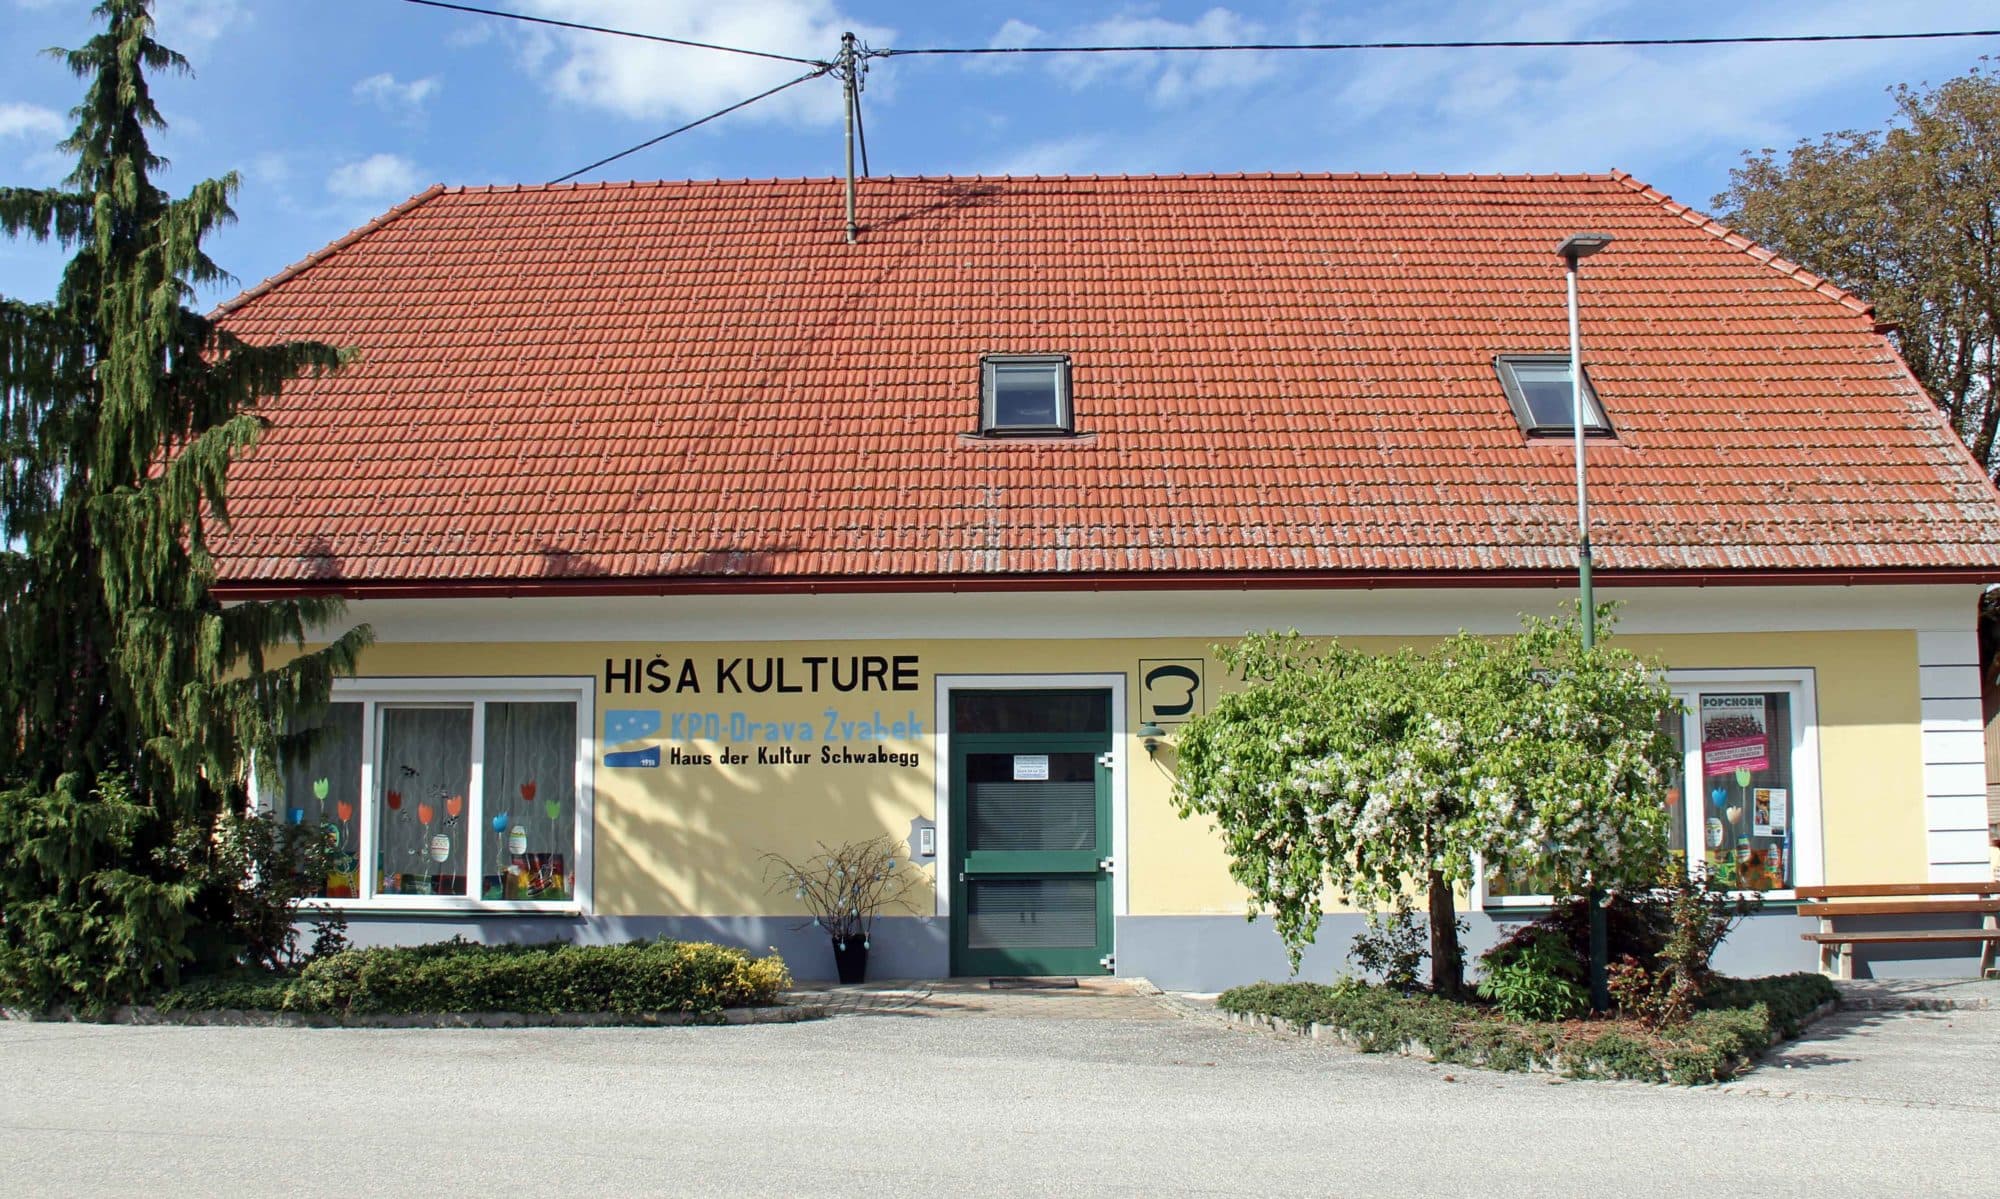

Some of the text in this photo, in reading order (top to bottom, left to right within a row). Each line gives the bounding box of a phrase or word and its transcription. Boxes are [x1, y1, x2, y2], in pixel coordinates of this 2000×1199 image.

[605, 653, 919, 694] HIŠA KULTURE
[671, 706, 924, 742] KPD-Drava Žvabek
[670, 744, 919, 767] Haus der Kultur Schwabegg
